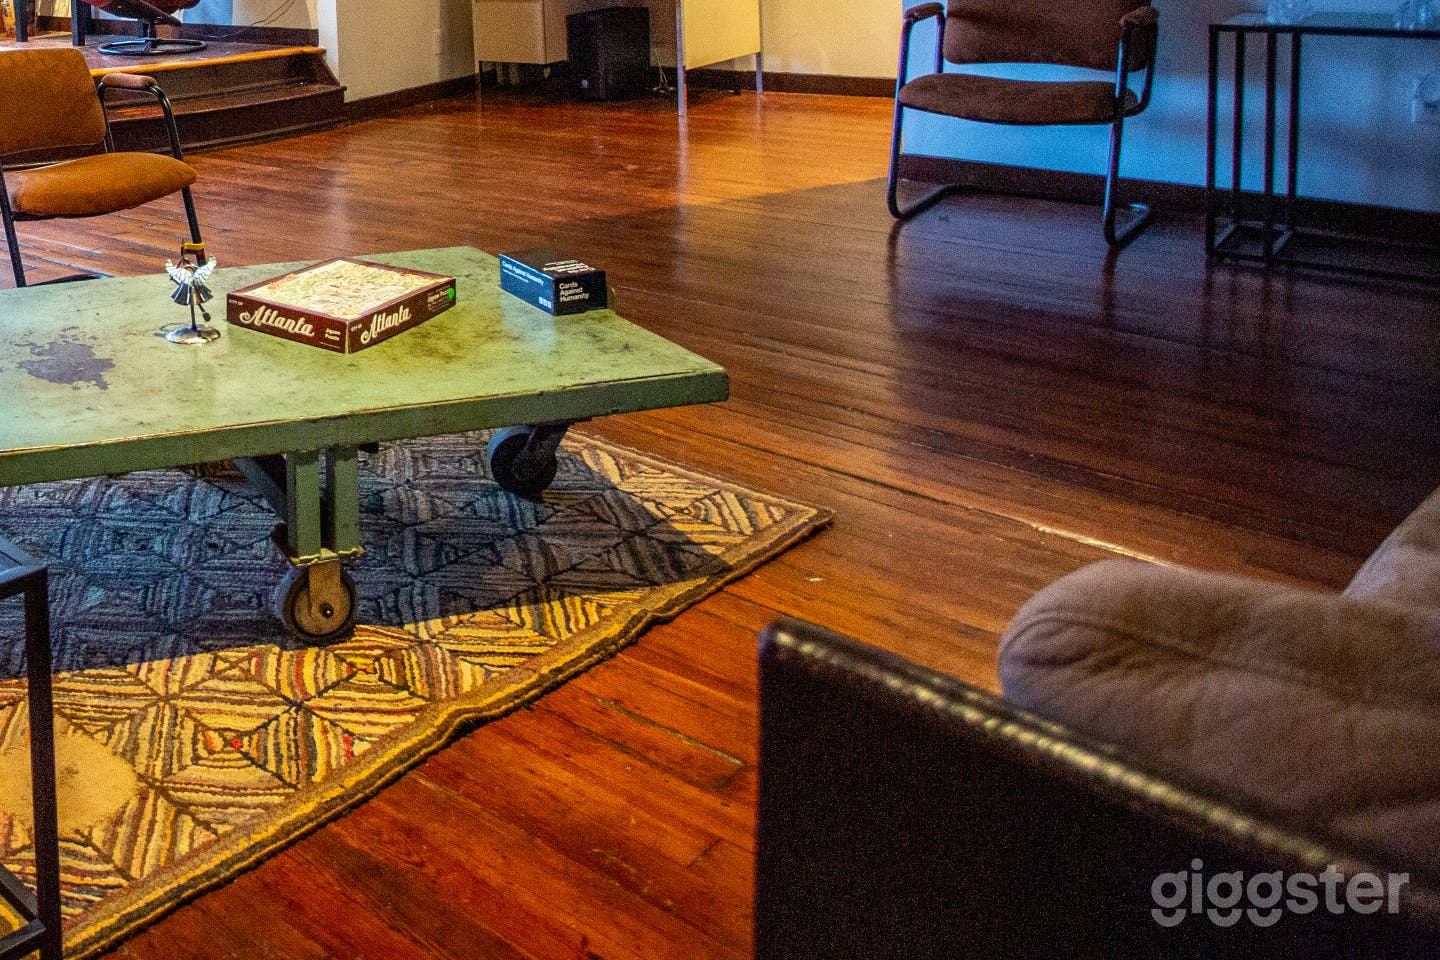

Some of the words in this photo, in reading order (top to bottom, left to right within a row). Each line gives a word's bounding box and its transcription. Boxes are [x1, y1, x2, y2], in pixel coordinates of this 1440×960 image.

[559, 282, 578, 290] Cards
[559, 287, 584, 296] Against
[560, 292, 589, 302] Humanity
[239, 305, 315, 337] Atlanta
[360, 305, 412, 344] Atlanta
